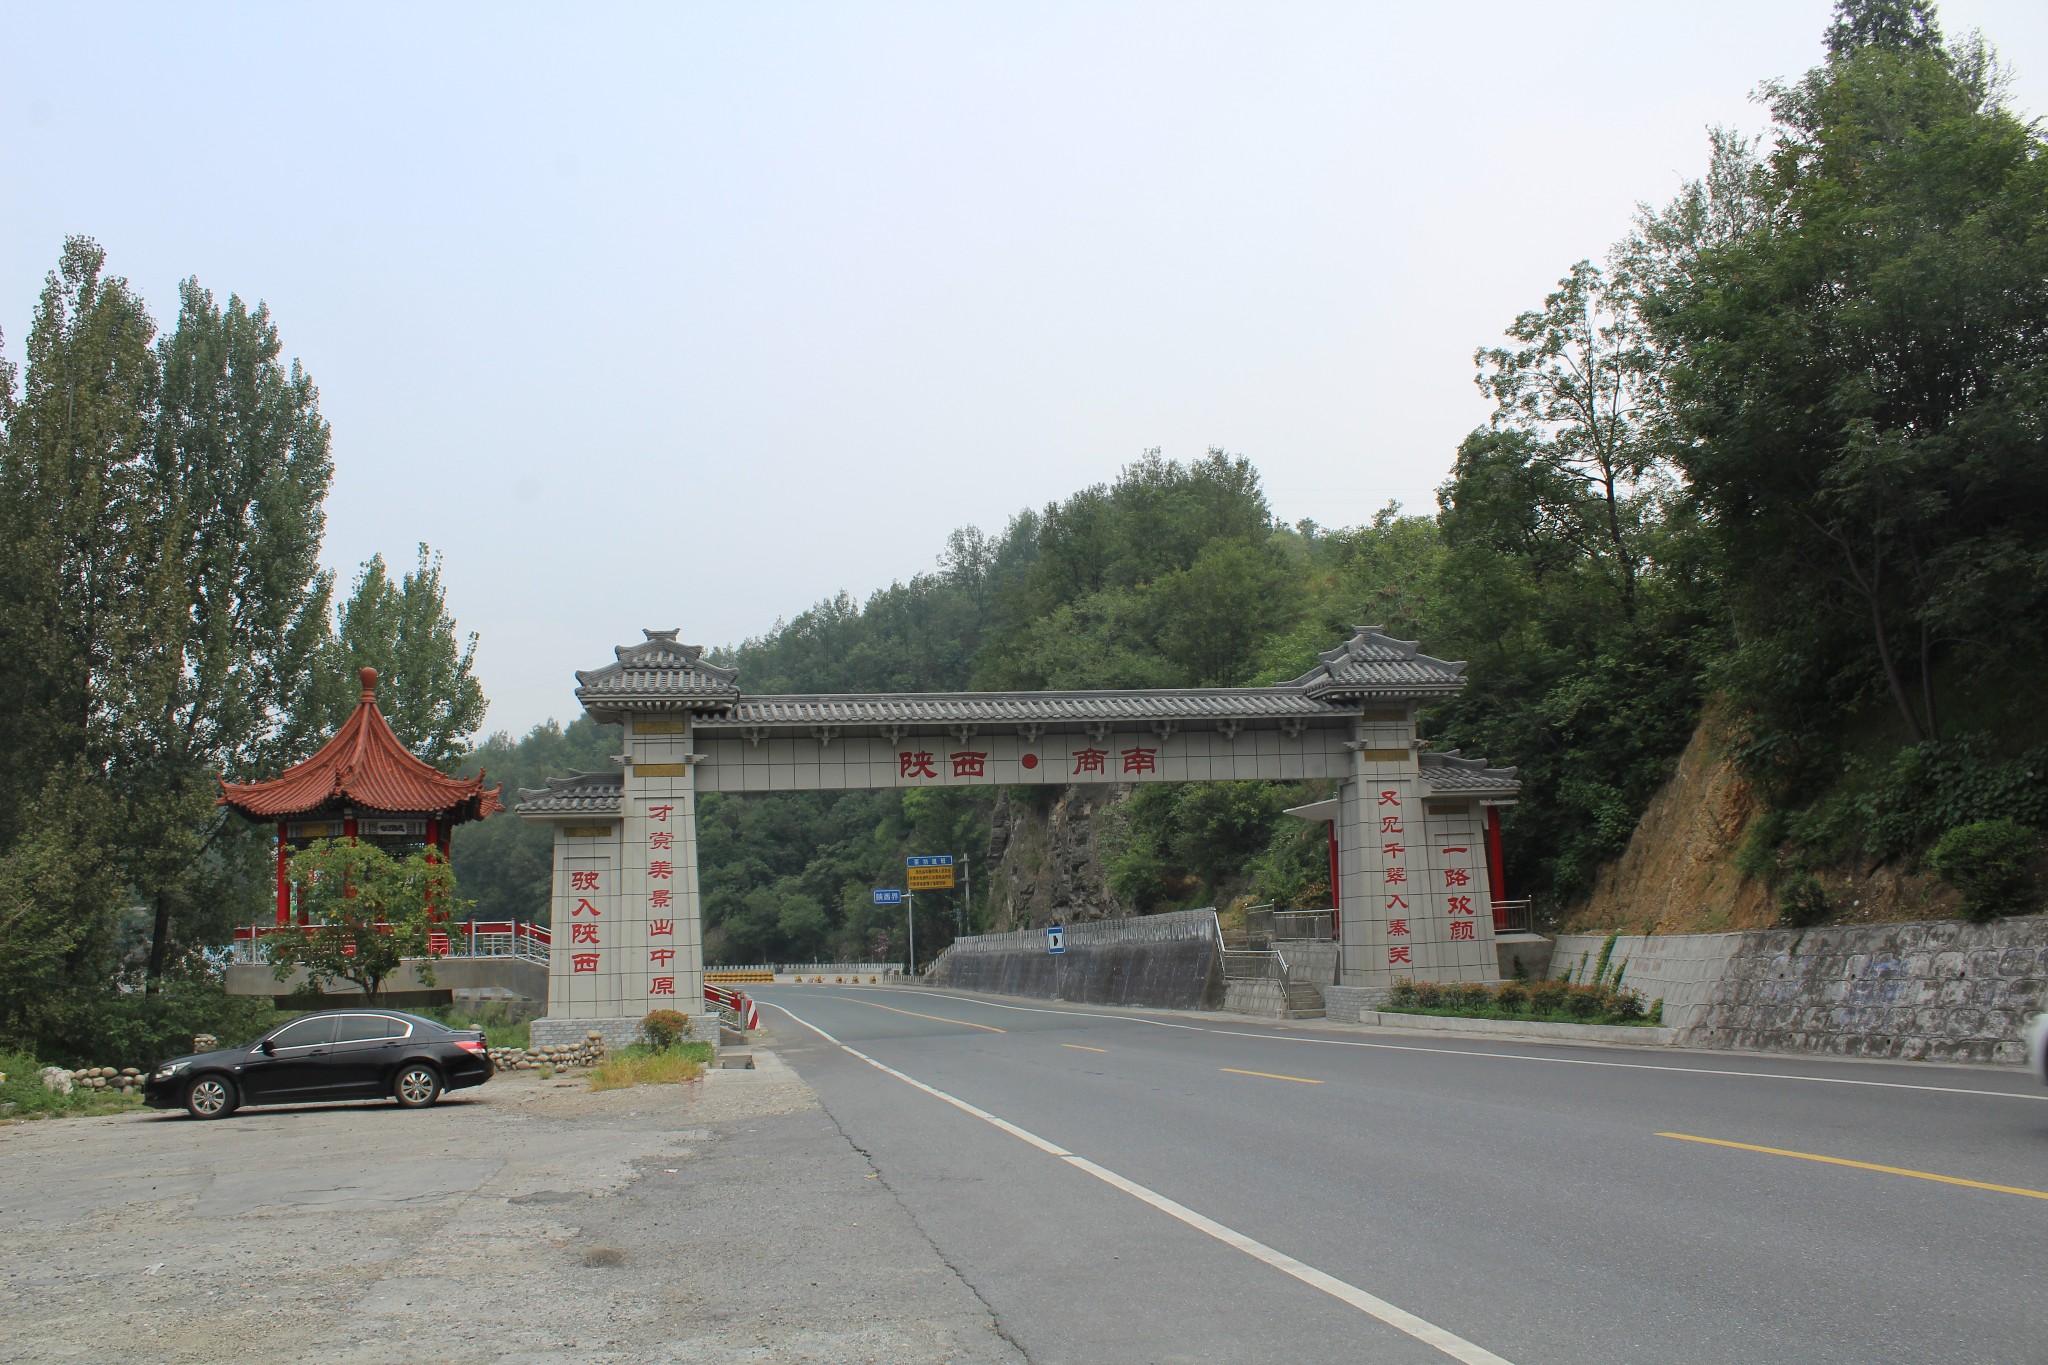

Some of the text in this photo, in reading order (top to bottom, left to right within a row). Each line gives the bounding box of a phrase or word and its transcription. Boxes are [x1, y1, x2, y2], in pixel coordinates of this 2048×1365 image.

[571, 871, 601, 974] 驶入陕西
[647, 805, 676, 996] 才赏美景出中原
[1442, 847, 1475, 941] 一路欢颜
